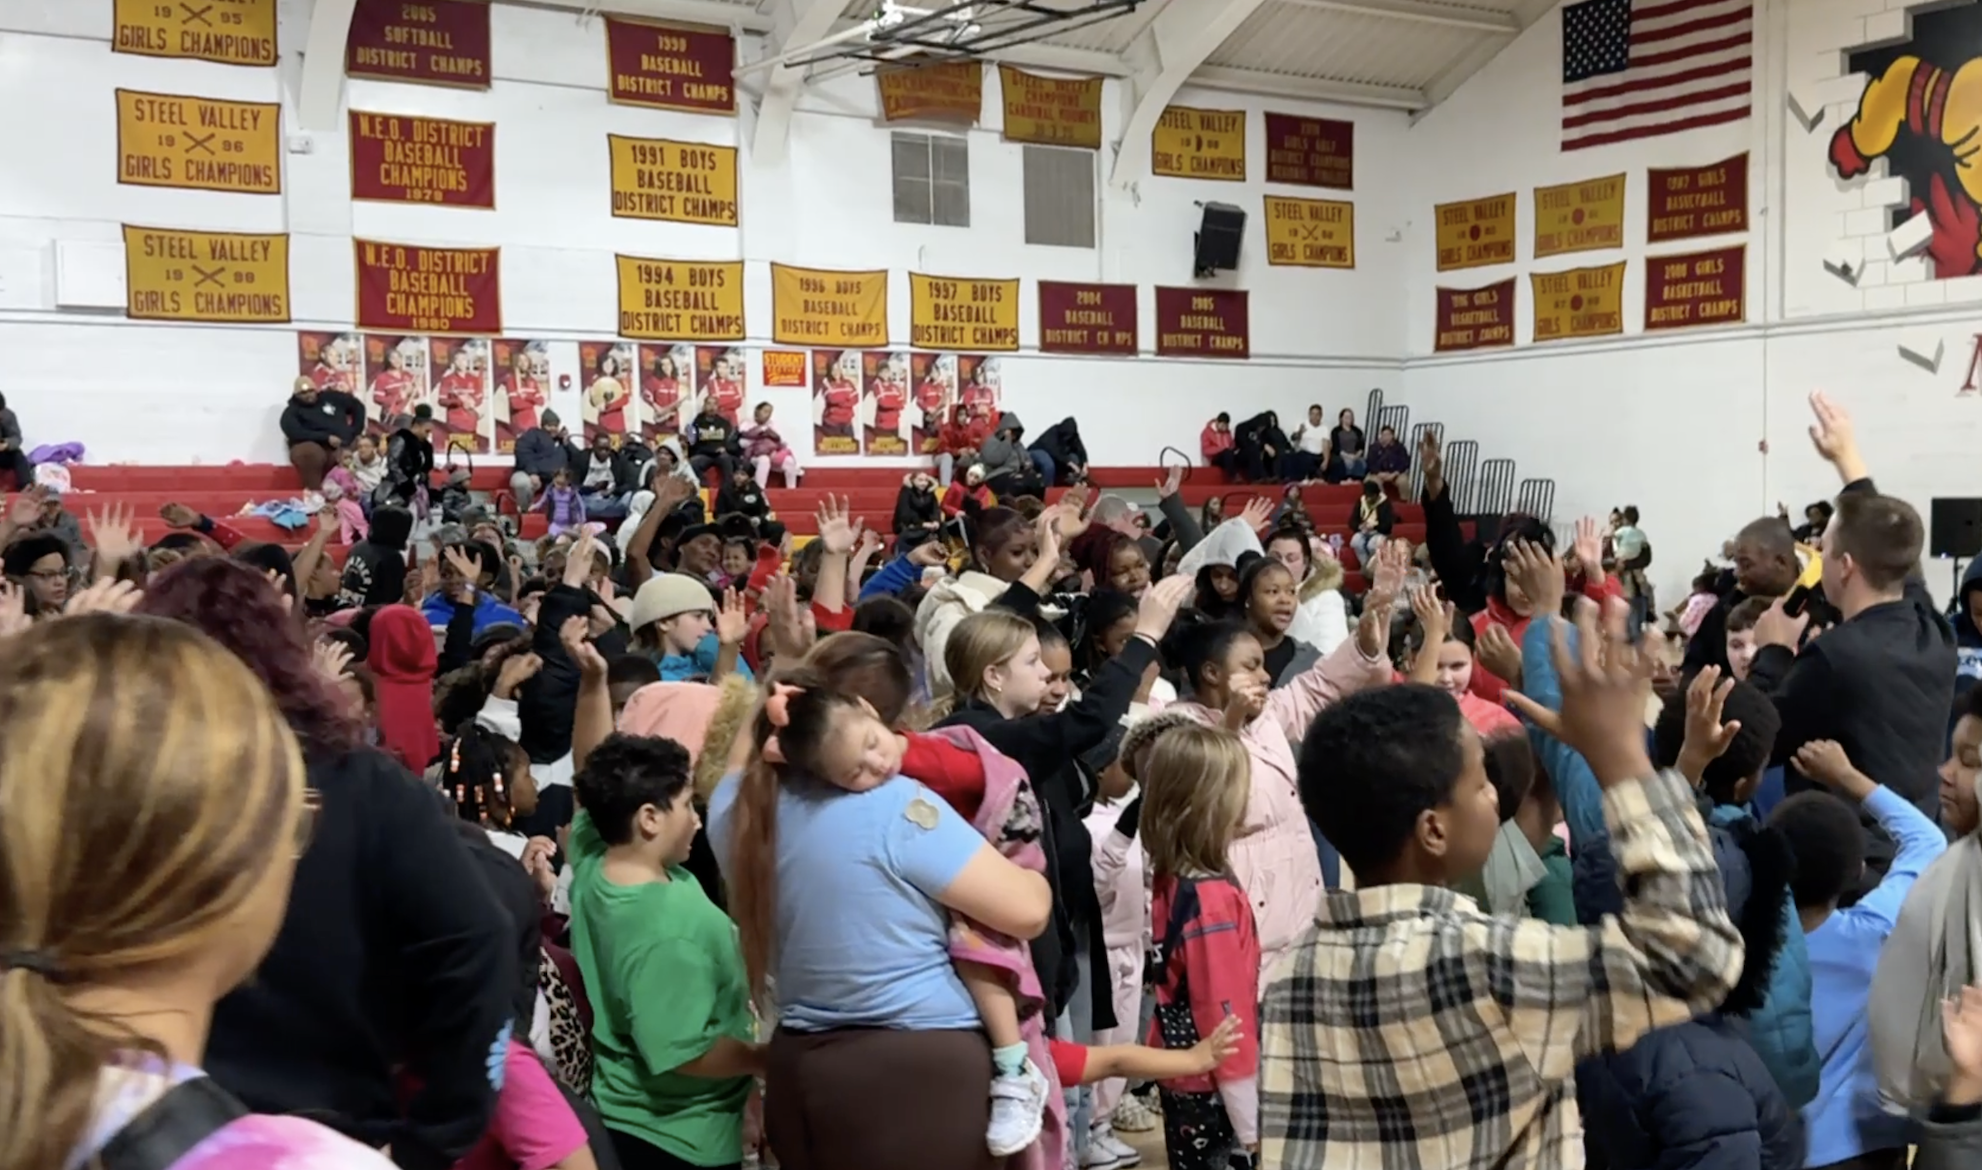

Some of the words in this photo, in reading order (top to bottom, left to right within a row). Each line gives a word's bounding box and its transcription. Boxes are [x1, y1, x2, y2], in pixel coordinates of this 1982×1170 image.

[119, 25, 167, 50] GIRLS
[180, 30, 271, 60] CHAMPIONS
[384, 25, 453, 49] SOFTBALL
[356, 47, 417, 69] DISTRICT
[430, 55, 482, 76] CHAMPS
[641, 54, 702, 77] BASEBALL
[617, 74, 672, 96] DISTRICT
[683, 82, 728, 102] CHAMPS
[135, 98, 188, 126] STEEL
[198, 105, 261, 131] VALLEY
[1161, 111, 1192, 130] STEEL
[1199, 114, 1237, 133] VALLEY
[158, 134, 175, 147] 19
[360, 115, 405, 140] N.E.O.
[413, 120, 484, 148] DISTRICT
[384, 140, 462, 168] BASEBALL
[631, 145, 665, 166] 1991
[680, 149, 717, 171] BOYS
[1155, 151, 1182, 171] GIRLS
[1191, 156, 1242, 175] CHAMPIONS
[125, 154, 172, 179] GIRLS
[185, 159, 272, 187] CHAMPIONS
[380, 163, 467, 191] CHAMPIONS
[637, 168, 712, 195] BASEBALL
[1698, 167, 1726, 187] GIRLS
[614, 190, 675, 215] DISTRICT
[683, 197, 736, 220] CHAMPS
[1543, 189, 1570, 210] STEEL
[1580, 181, 1617, 203] VALLEY
[1666, 190, 1726, 212] BASKETBALL
[1274, 202, 1304, 220] STEEL
[1309, 204, 1342, 223] VALLEY
[1443, 206, 1469, 226] STEEL
[1474, 201, 1505, 221] VALLEY
[1653, 214, 1694, 233] DISTRICT
[1703, 209, 1741, 228] CHAMPS
[144, 234, 198, 259] STEEL
[208, 238, 270, 262] VALLEY
[1539, 231, 1562, 251] GIRLS
[1568, 224, 1619, 247] CHAMPIONS
[366, 243, 411, 270] N.E.O.
[418, 250, 489, 273] DISTRICT
[1272, 243, 1295, 259] GIRLS
[1303, 243, 1347, 262] CHAMPIONS
[1440, 245, 1461, 265] GIRLS
[1467, 239, 1511, 261] CHAMPIONS
[637, 264, 674, 285] 1994
[688, 267, 725, 288] BOYS
[1695, 258, 1724, 275] GIRLS
[389, 269, 468, 295] BASEBALL
[835, 280, 861, 295] BOYS
[928, 281, 957, 300] 1997
[971, 283, 1002, 302] BOYS
[1540, 276, 1570, 294] STEEL
[1577, 270, 1613, 290] VALLEY
[1663, 280, 1723, 300] BASKETBALL
[134, 290, 181, 313] GIRLS
[195, 291, 282, 316] CHAMPIONS
[386, 293, 474, 319] CHAMPIONS
[644, 288, 719, 311] BASEBALL
[803, 299, 858, 316] BASEBALL
[1474, 290, 1498, 305] GIRLS
[622, 310, 682, 332] DISTRICT
[690, 314, 742, 334] CHAMPS
[934, 302, 997, 324] BASEBALL
[1065, 309, 1114, 326] BASEBALL
[1181, 314, 1225, 331] BASEBALL
[1538, 315, 1560, 335] GIRLS
[1570, 310, 1618, 332] CHAMPIONS
[1651, 304, 1690, 322] DISTRICT
[1699, 299, 1737, 318] CHAMPS
[781, 318, 829, 336] DISTRICT
[840, 322, 881, 337] CHAMPS
[913, 324, 965, 344] DISTRICT
[972, 326, 1017, 345] CHAMPS
[1045, 328, 1088, 344] DISTRICT
[1440, 330, 1473, 345] DISTRICT
[1163, 333, 1201, 348] DISTRICT
[1210, 335, 1243, 350] CHAMPS
